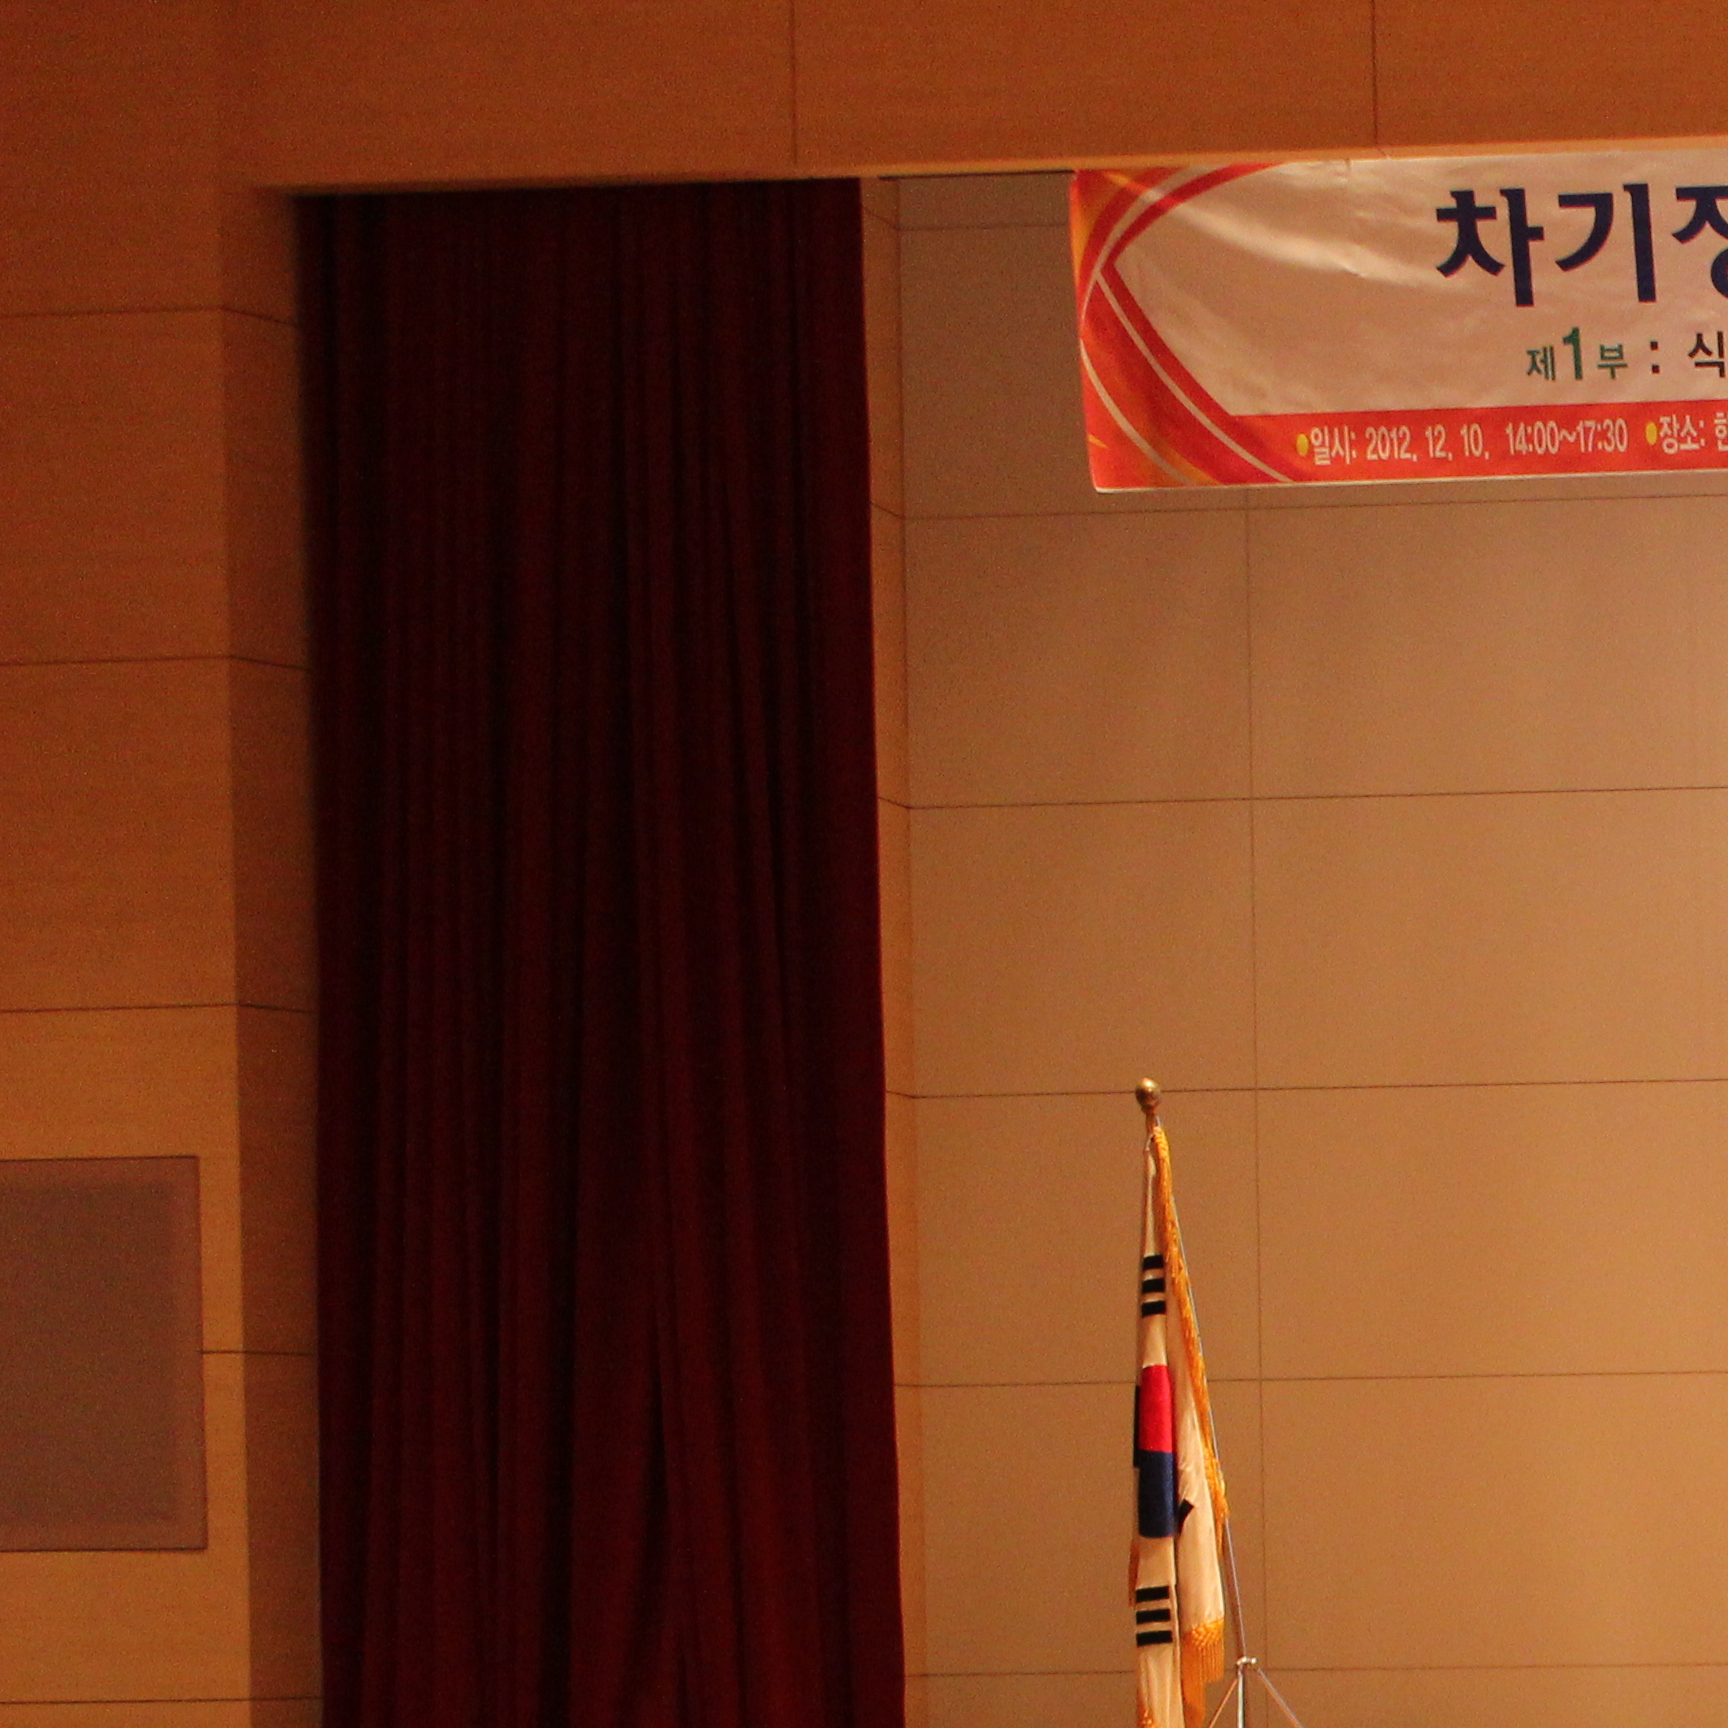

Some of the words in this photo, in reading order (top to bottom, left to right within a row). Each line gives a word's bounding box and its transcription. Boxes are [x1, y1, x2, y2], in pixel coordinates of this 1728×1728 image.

[1527, 328, 1627, 381] 제1부
[1309, 427, 1357, 465] 일시:
[1658, 416, 1705, 454] 장소:
